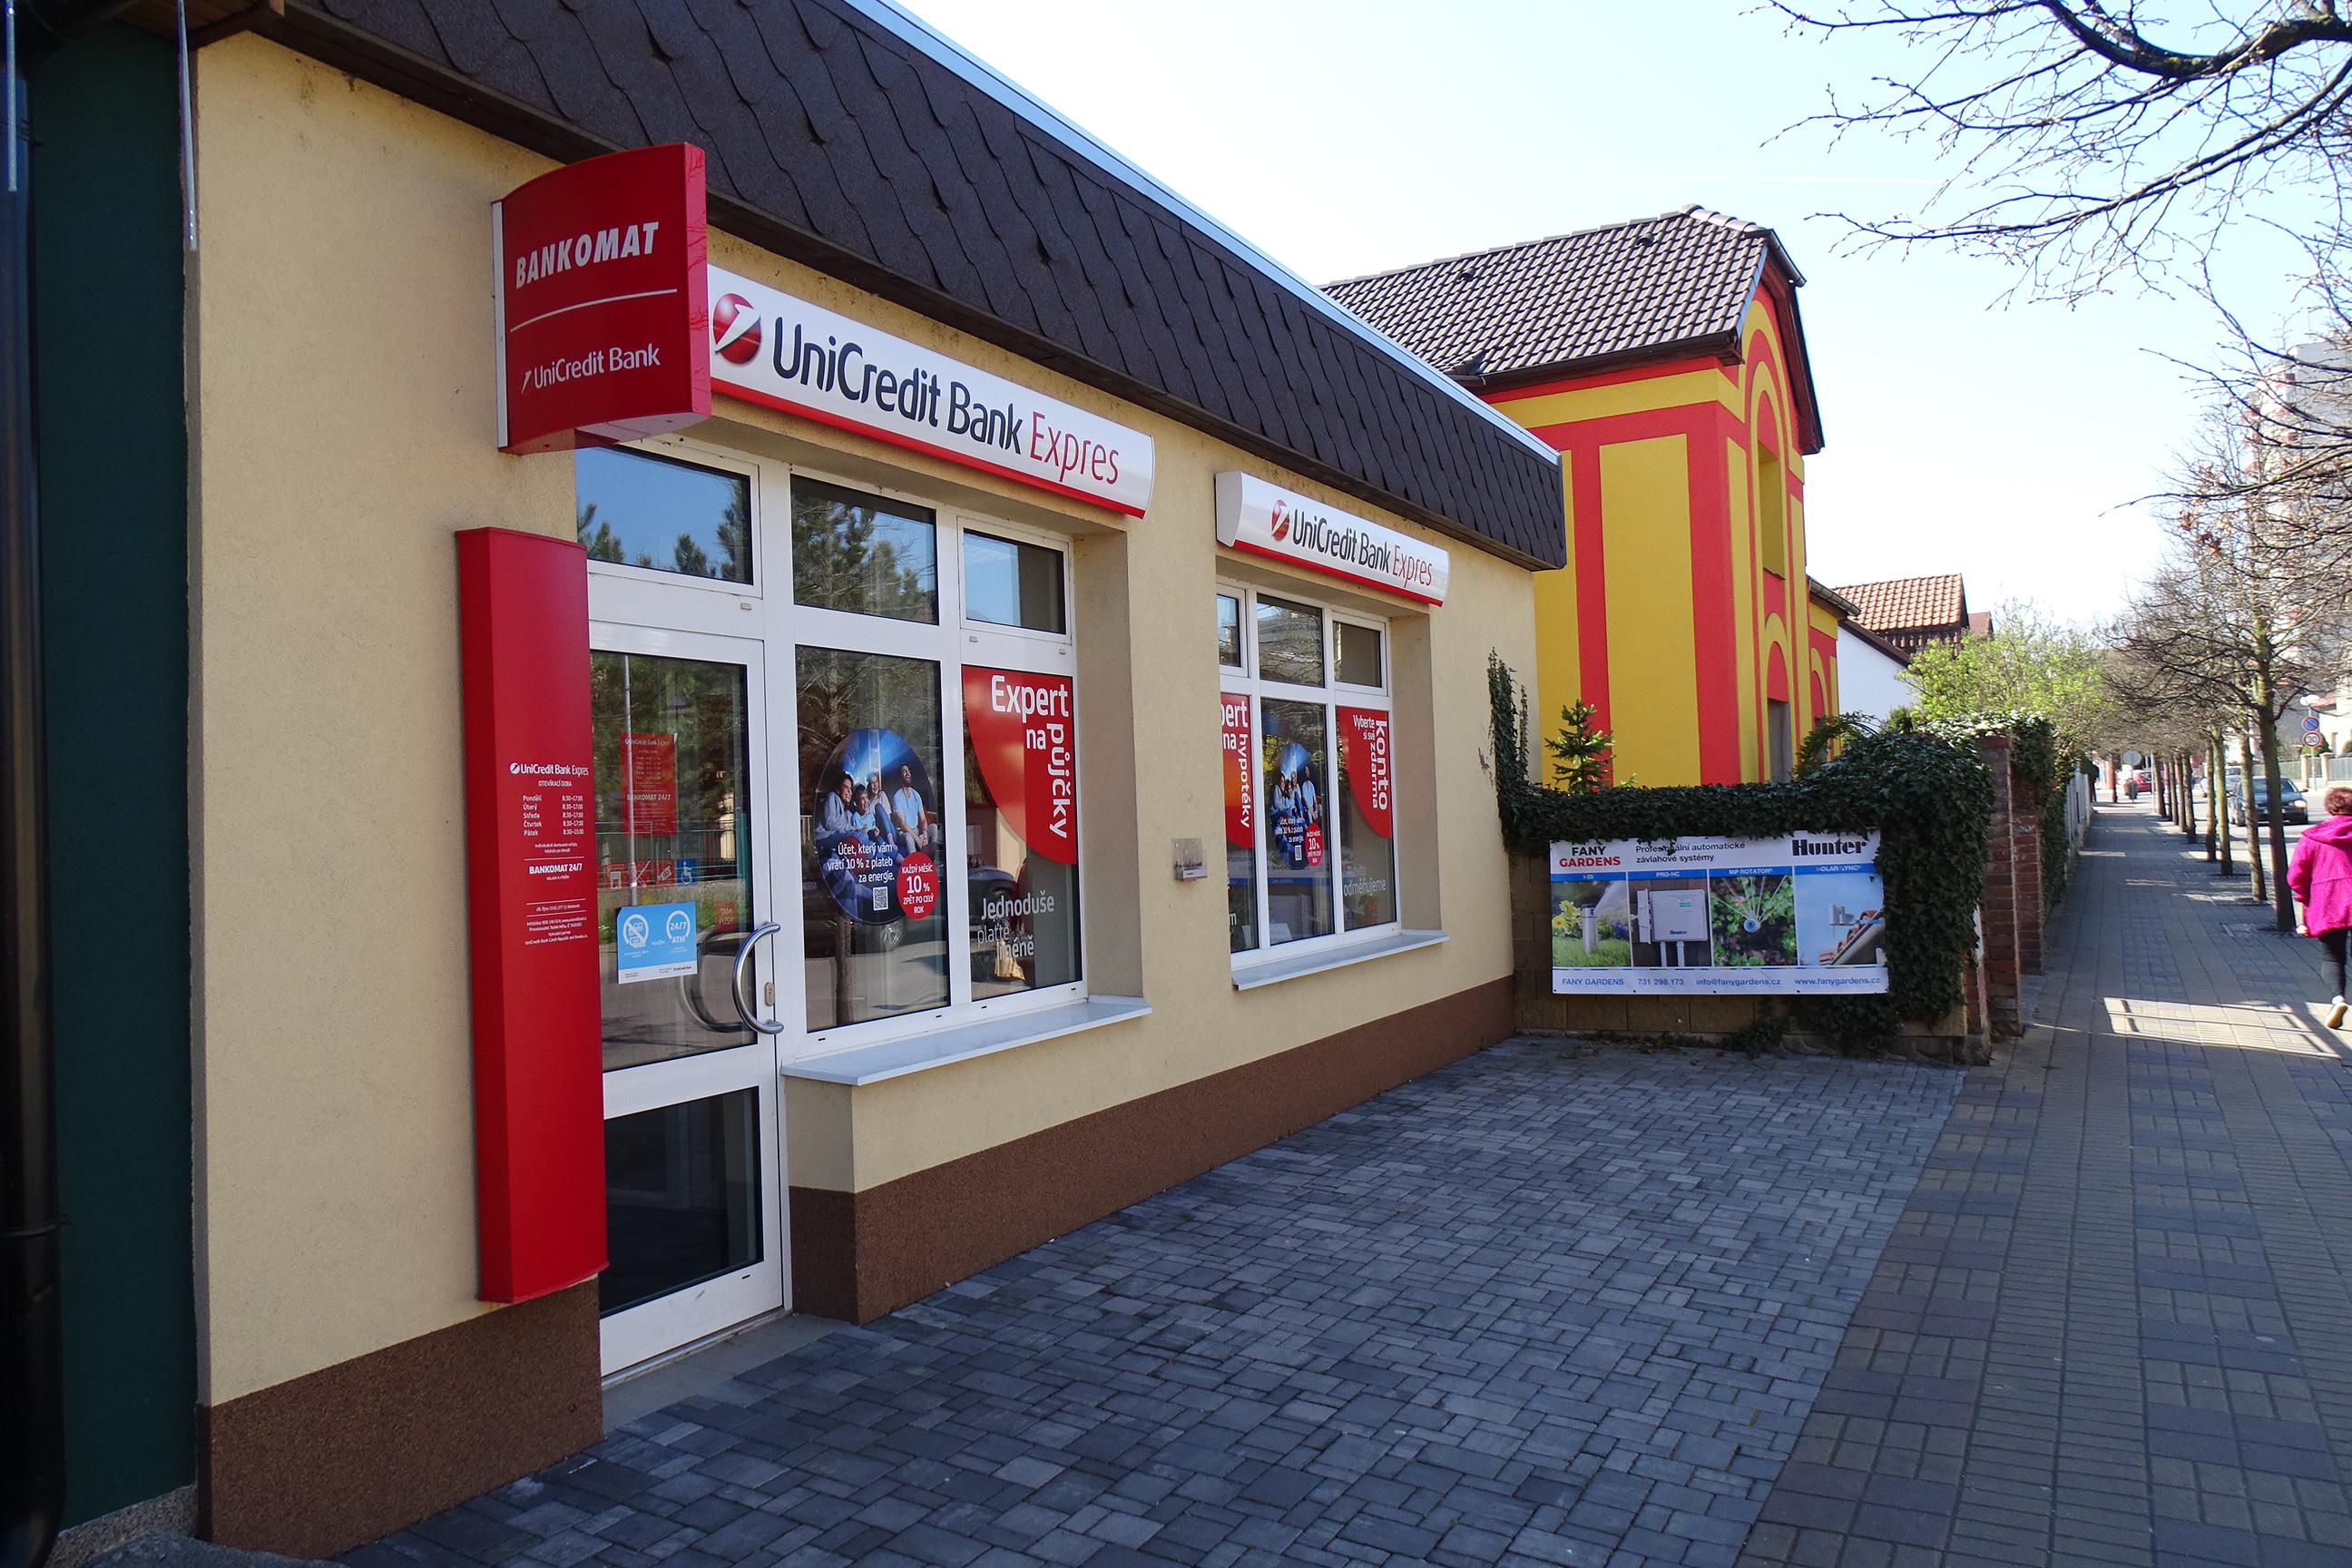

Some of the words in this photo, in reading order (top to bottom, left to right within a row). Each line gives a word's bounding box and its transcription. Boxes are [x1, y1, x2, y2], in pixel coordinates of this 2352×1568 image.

[515, 220, 660, 290] BANKOMAT
[534, 349, 605, 390] UniCredit
[608, 342, 662, 373] Bank
[773, 316, 941, 428] UniCredit
[946, 381, 1024, 455] Bank
[1029, 410, 1120, 485] Expres
[1292, 508, 1358, 564] UniCredit
[1357, 532, 1392, 574] Bank
[1392, 544, 1433, 589] Expres
[991, 674, 1070, 724] Expert
[1352, 714, 1376, 730] Vyberte
[1025, 728, 1047, 750] na
[1222, 731, 1238, 750] na
[2308, 735, 2317, 743] 30
[520, 763, 554, 775] UniCredit
[554, 763, 572, 775] Bank
[572, 764, 589, 778] Expres
[1376, 720, 1388, 810] konto
[1046, 722, 1072, 839] půjčky
[1237, 732, 1252, 828] hypotéky
[1370, 741, 1378, 808] zdarma
[838, 841, 858, 857] Účet,
[858, 842, 877, 856] který
[877, 842, 894, 854] vám
[1308, 838, 1317, 850] 10
[1572, 845, 1606, 857] FANY
[1691, 841, 1746, 852] automatické
[1791, 838, 1867, 857] Hunter
[827, 858, 845, 871] vrátí
[846, 858, 856, 870] 10
[857, 858, 864, 869] %
[865, 860, 870, 868] z
[871, 856, 894, 870] plateb
[1558, 856, 1622, 868] GARDENS
[1636, 855, 1678, 864] závlahové
[1679, 853, 1715, 863] systémy
[528, 864, 568, 875] BANKOMAT
[568, 862, 583, 872] 24/7
[858, 874, 867, 883] za
[867, 871, 896, 884] energie.
[906, 875, 922, 894] 10
[923, 883, 931, 893] %
[916, 896, 923, 904] PO
[980, 888, 1055, 921] Jednoduše
[913, 905, 925, 915] ROK
[670, 920, 688, 932] 24/7
[1562, 977, 1582, 985] FANY
[1584, 977, 1624, 986] GARDENS
[1638, 977, 1651, 985] 731
[1653, 977, 1668, 986] 298
[1671, 977, 1684, 986] 173
[1696, 976, 1781, 987] info@fanygardens.cz
[1794, 975, 1881, 986] www.fanygardens.cz
